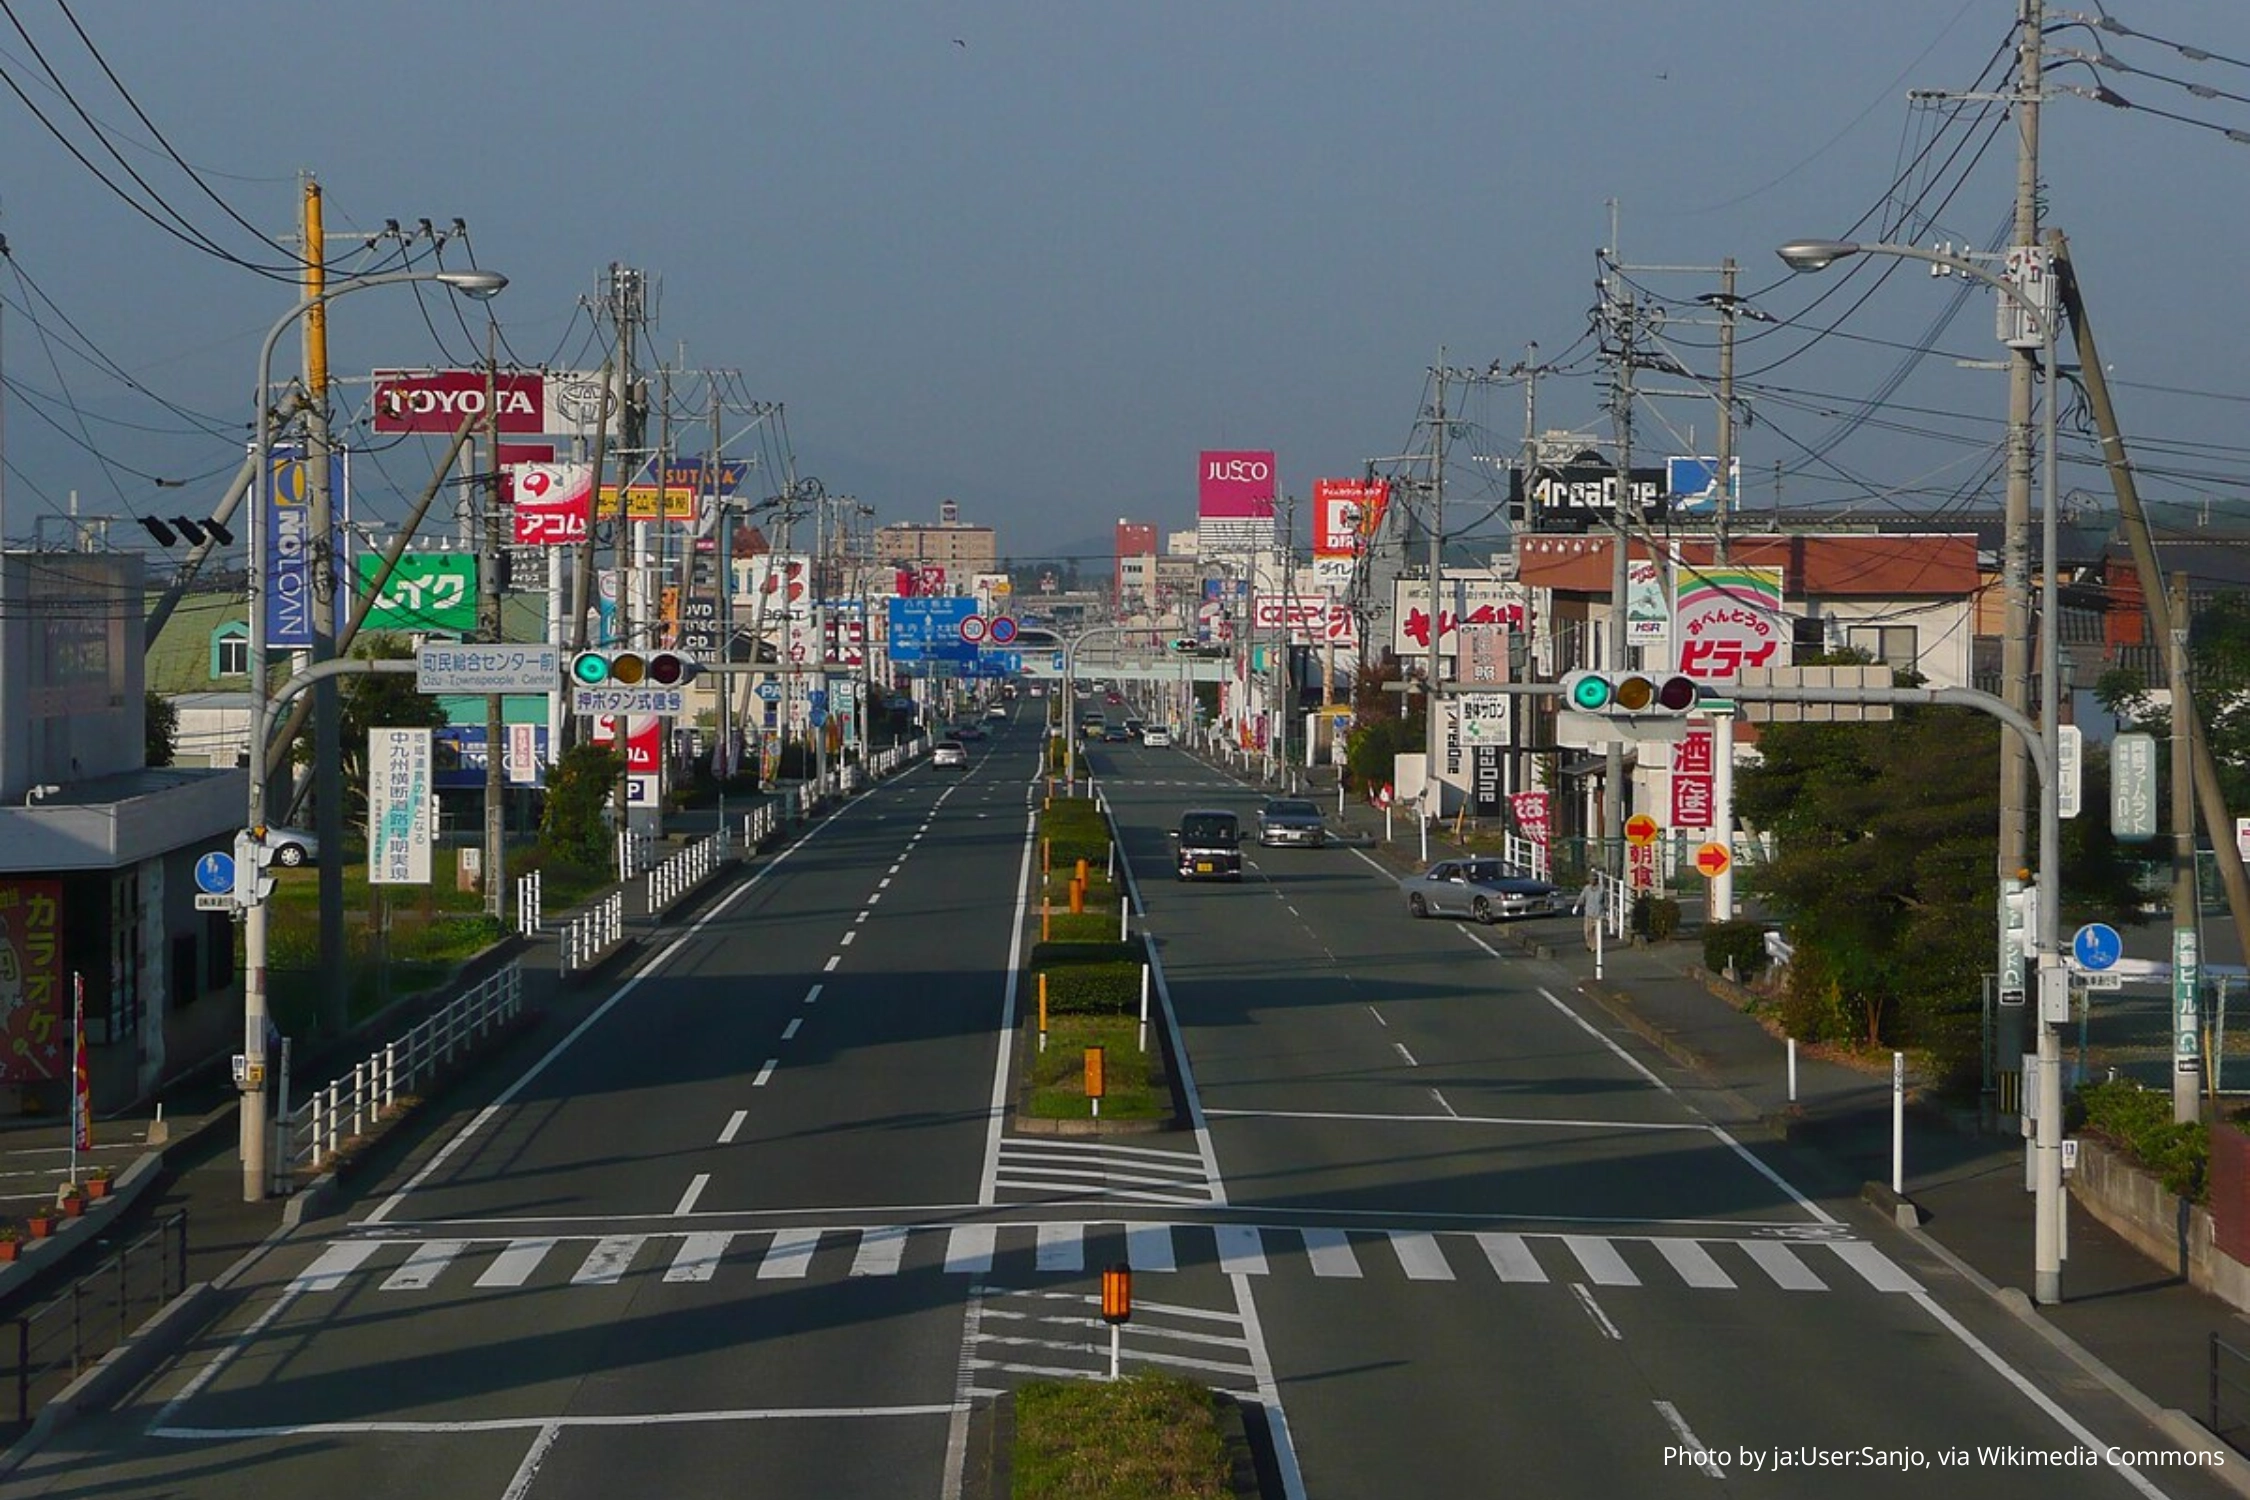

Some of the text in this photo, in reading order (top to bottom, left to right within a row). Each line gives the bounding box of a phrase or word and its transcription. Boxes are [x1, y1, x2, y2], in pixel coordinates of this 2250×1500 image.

[382, 390, 535, 414] TOYOTA
[1207, 460, 1268, 482] JUSCO
[521, 512, 587, 536] アコム
[424, 652, 554, 672] 町民総合センター前
[1679, 640, 1777, 677] ヒライ
[422, 674, 555, 688] Ozu Townspeople Center
[577, 691, 682, 710] 押ボタン式信号
[628, 782, 640, 799] P
[1677, 778, 1710, 823] たばこ
[26, 891, 57, 1044] カラオケ
